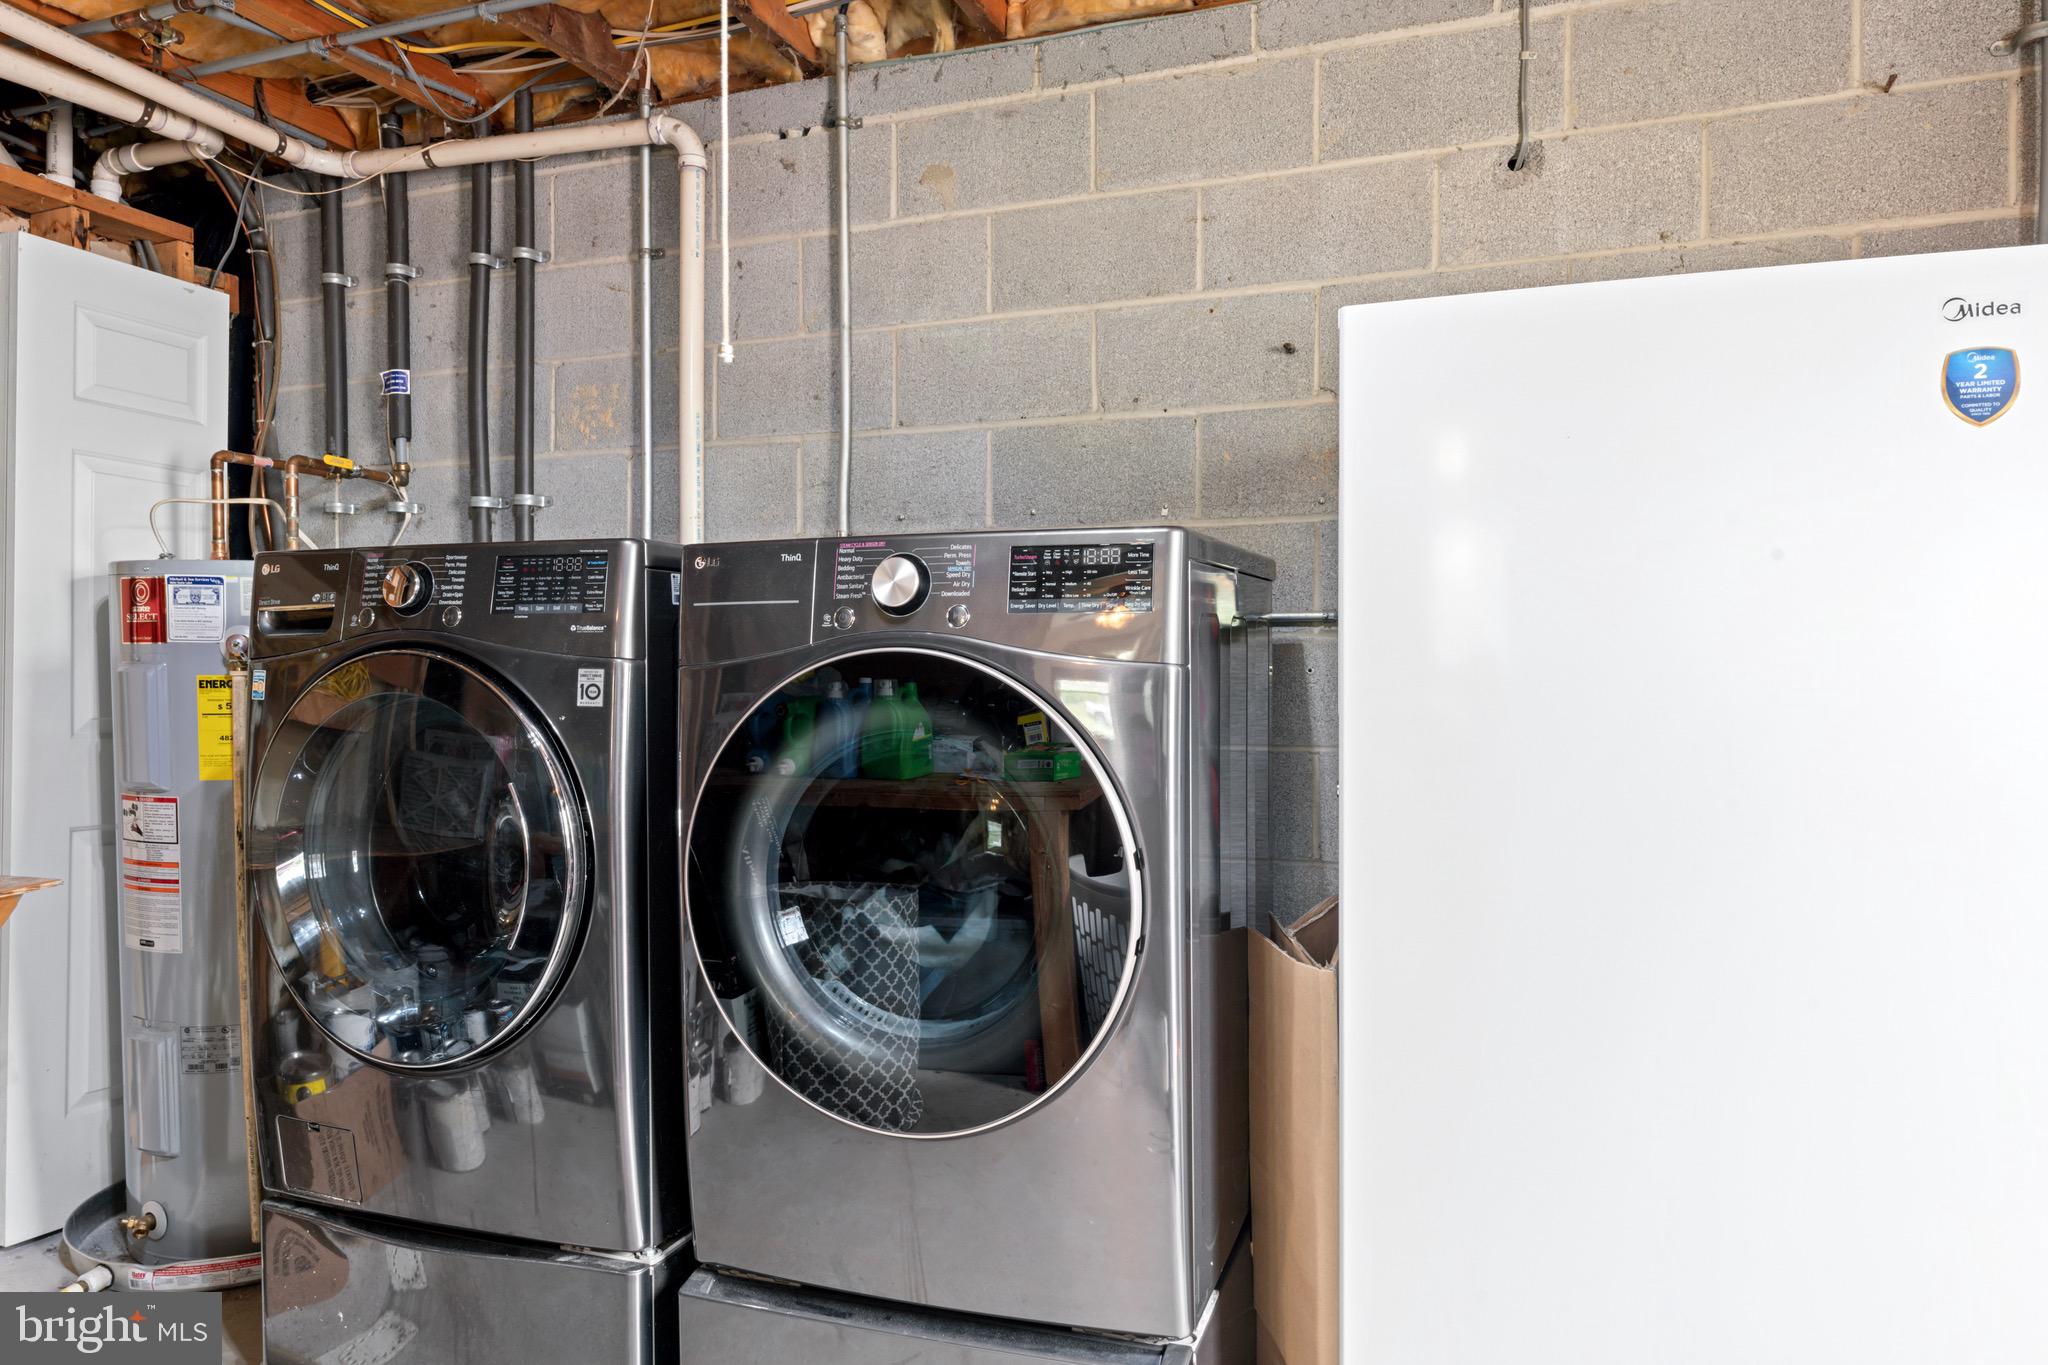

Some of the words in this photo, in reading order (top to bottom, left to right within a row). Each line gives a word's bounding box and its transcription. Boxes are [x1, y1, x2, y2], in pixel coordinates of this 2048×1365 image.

[1942, 298, 2021, 322] Midea
[1967, 352, 1995, 362] Midea
[1974, 364, 1988, 379] 2
[1960, 386, 2002, 394] WARRANTY
[780, 553, 802, 562] ThinQ
[270, 564, 280, 573] LG
[324, 563, 340, 571] ThinQ
[199, 680, 232, 688] ENERG
[580, 683, 601, 700] 10
[226, 702, 232, 710] 5
